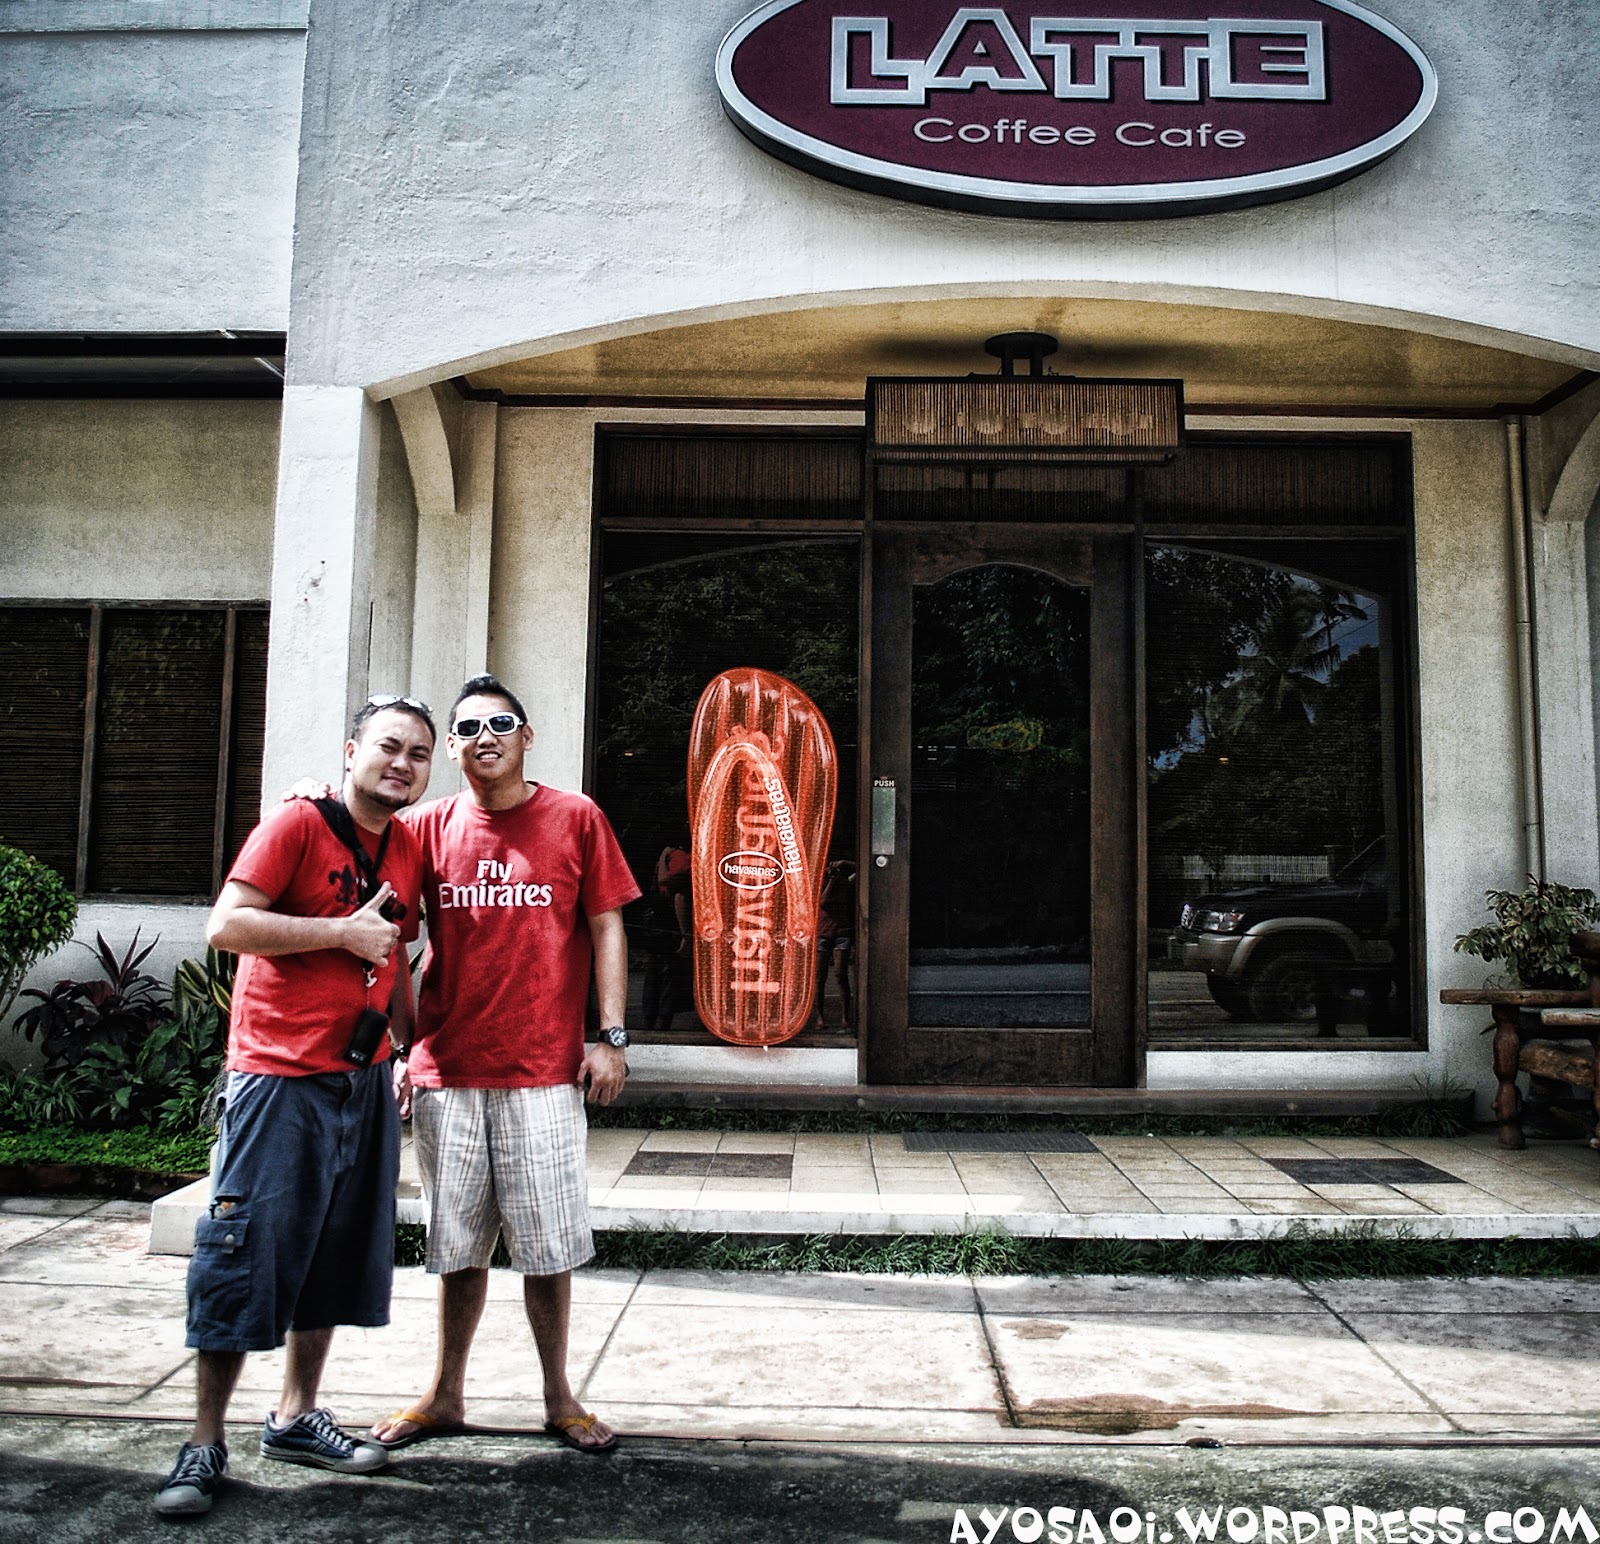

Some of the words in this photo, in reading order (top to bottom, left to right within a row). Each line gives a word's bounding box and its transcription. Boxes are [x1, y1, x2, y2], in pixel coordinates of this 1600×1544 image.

[830, 7, 1327, 105] LATTE
[913, 117, 1097, 145] Coffee
[1115, 122, 1246, 148] Cafe
[874, 779, 895, 787] PUSH
[763, 777, 803, 874] havaianas
[476, 859, 513, 884] Fly
[724, 862, 777, 877] havaianas
[439, 879, 553, 908] Emirates
